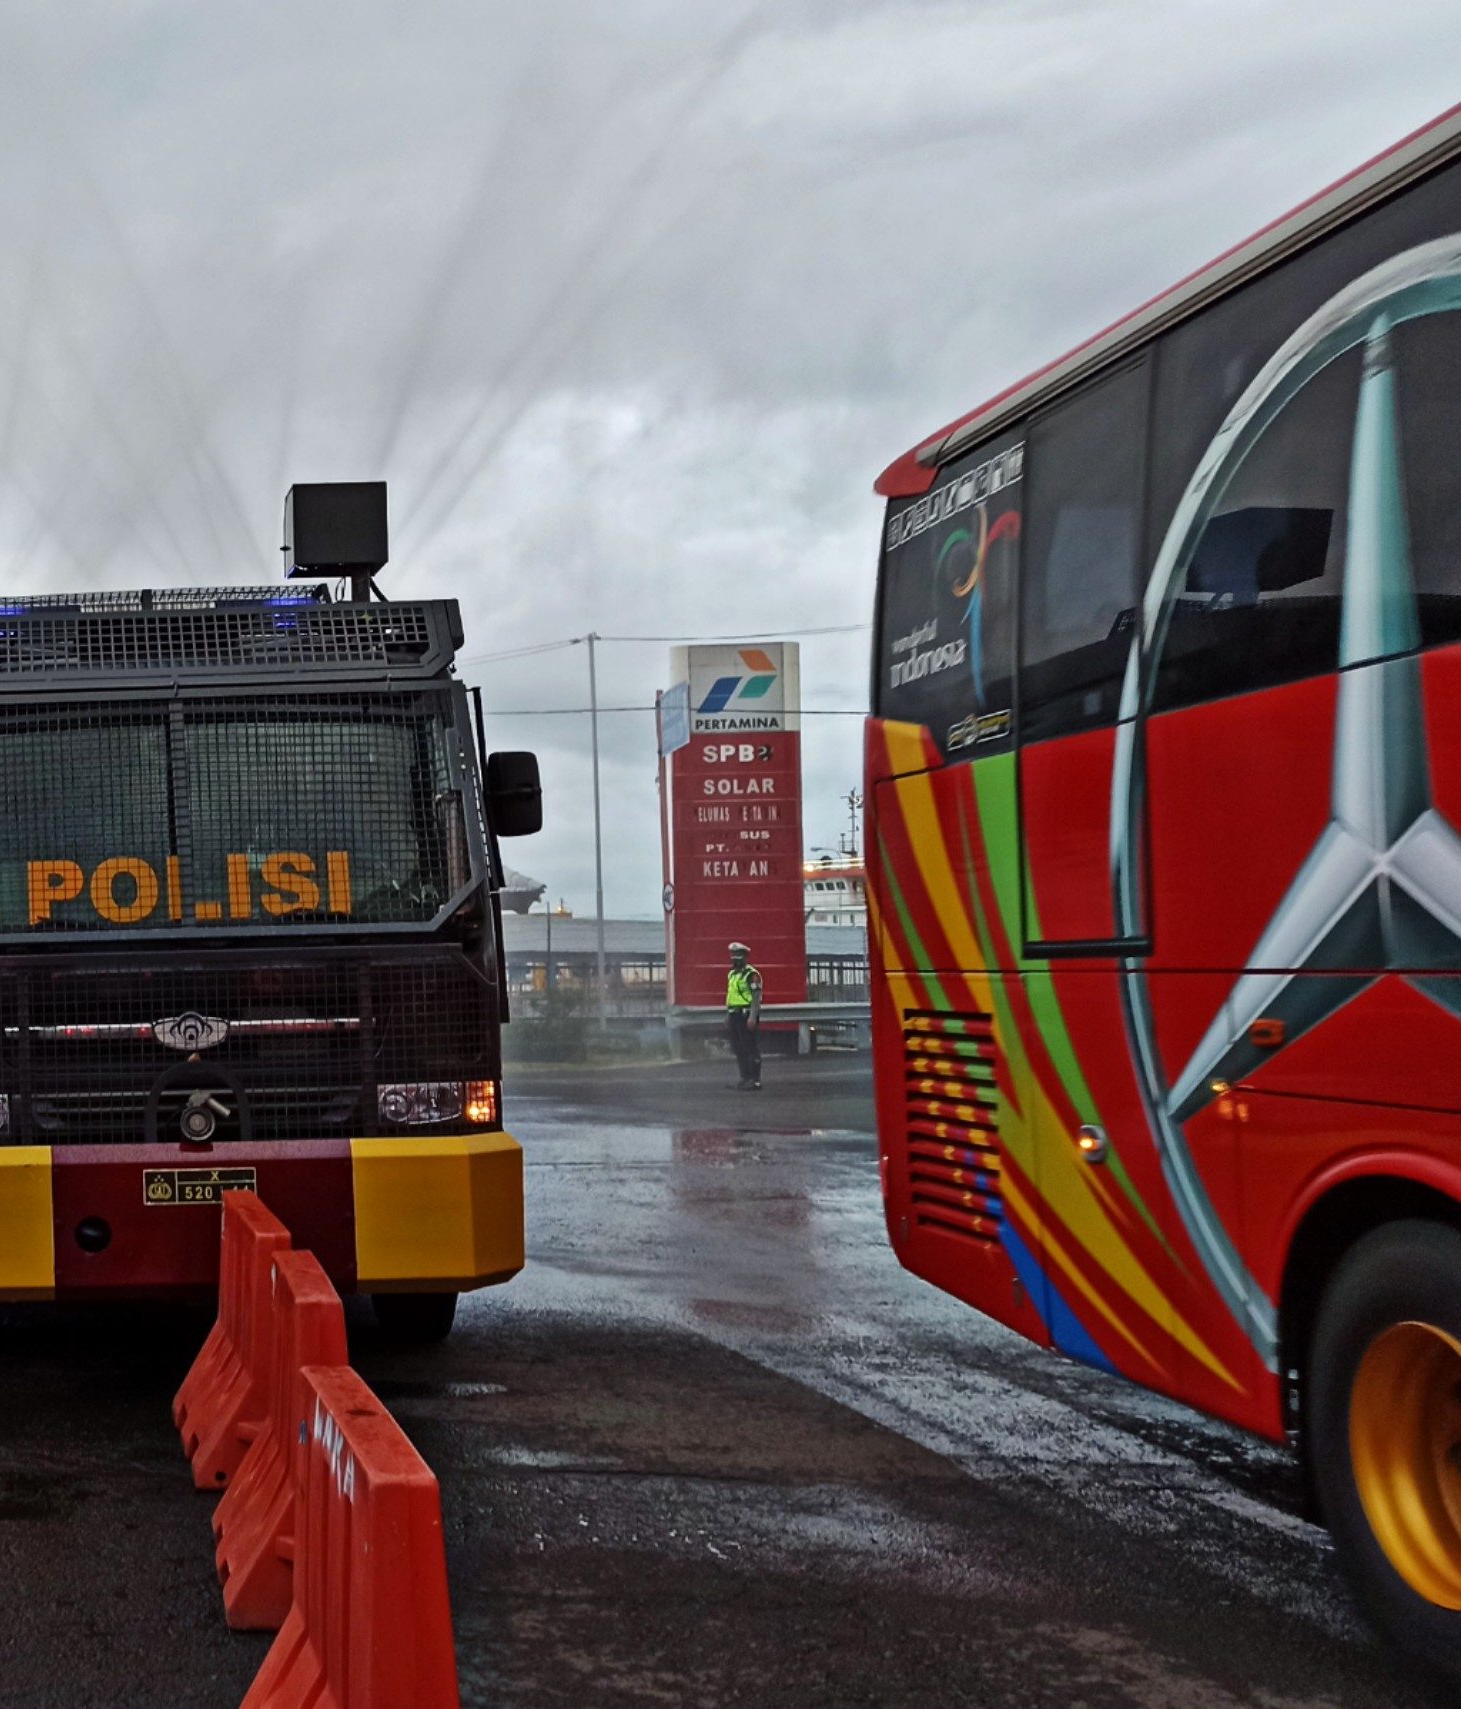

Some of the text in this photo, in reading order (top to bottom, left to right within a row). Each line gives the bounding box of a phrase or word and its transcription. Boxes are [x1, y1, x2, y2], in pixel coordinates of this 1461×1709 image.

[695, 717, 779, 730] PERTAMINA
[703, 778, 775, 795] SOLAR
[27, 851, 352, 925] POLISI
[211, 1170, 220, 1181] X
[185, 1186, 214, 1200] 520
